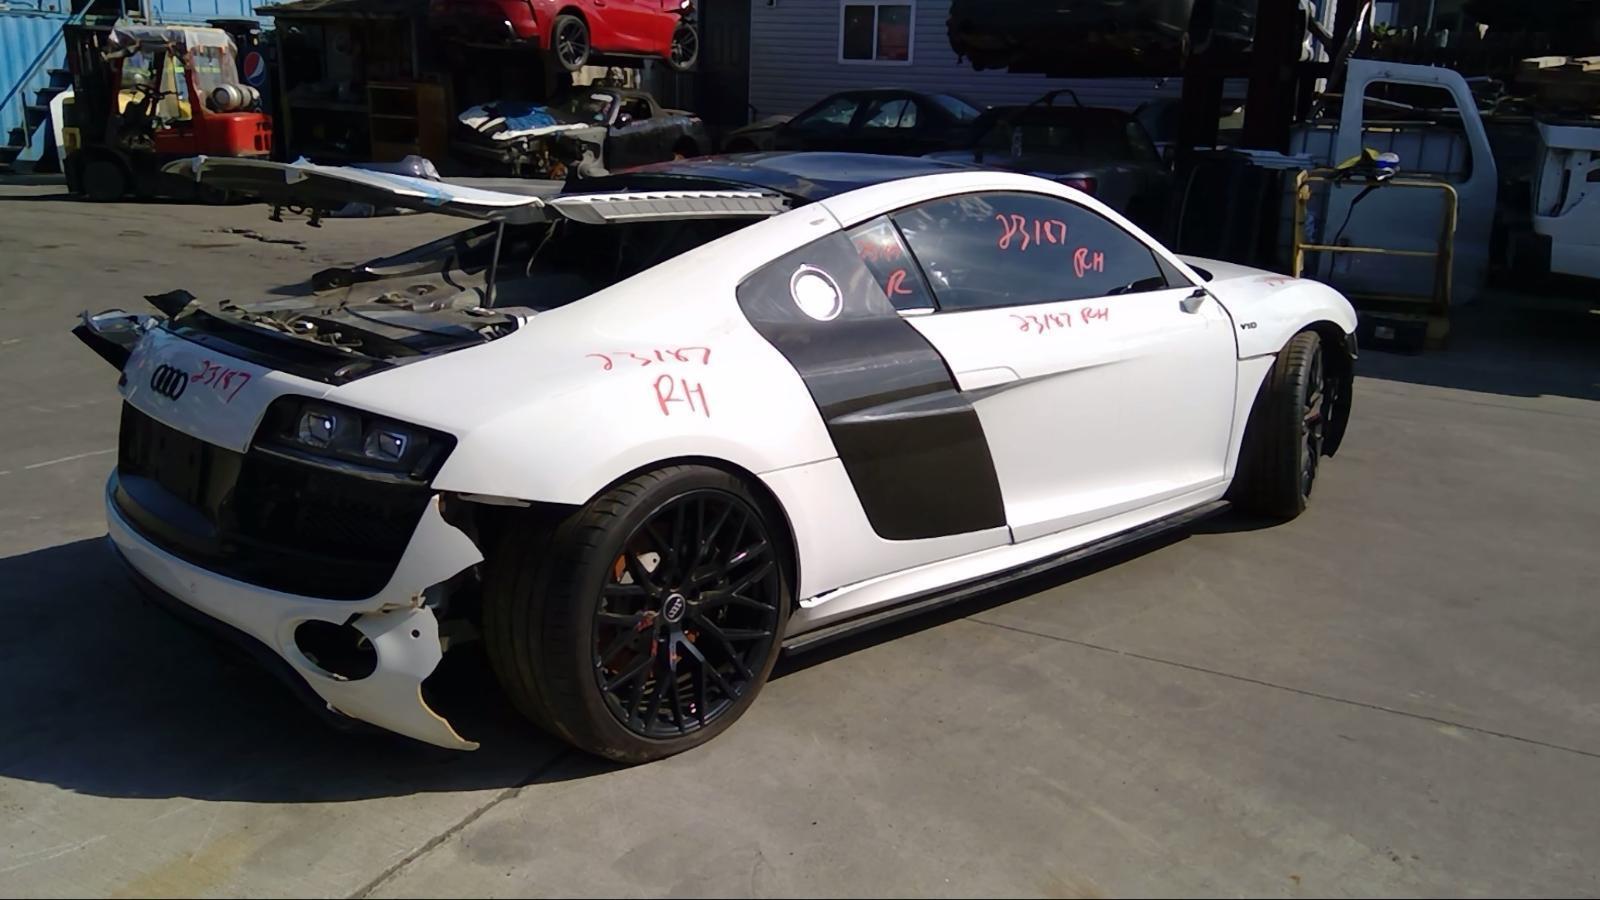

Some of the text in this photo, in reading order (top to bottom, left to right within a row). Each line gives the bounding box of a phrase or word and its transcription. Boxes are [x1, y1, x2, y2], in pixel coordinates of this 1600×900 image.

[995, 214, 1067, 251] 23187
[1073, 247, 1105, 278] RH
[1009, 306, 1109, 335] 23187 RH
[1240, 321, 1257, 330] V10
[190, 359, 252, 404] 23187
[653, 373, 710, 418] RH
